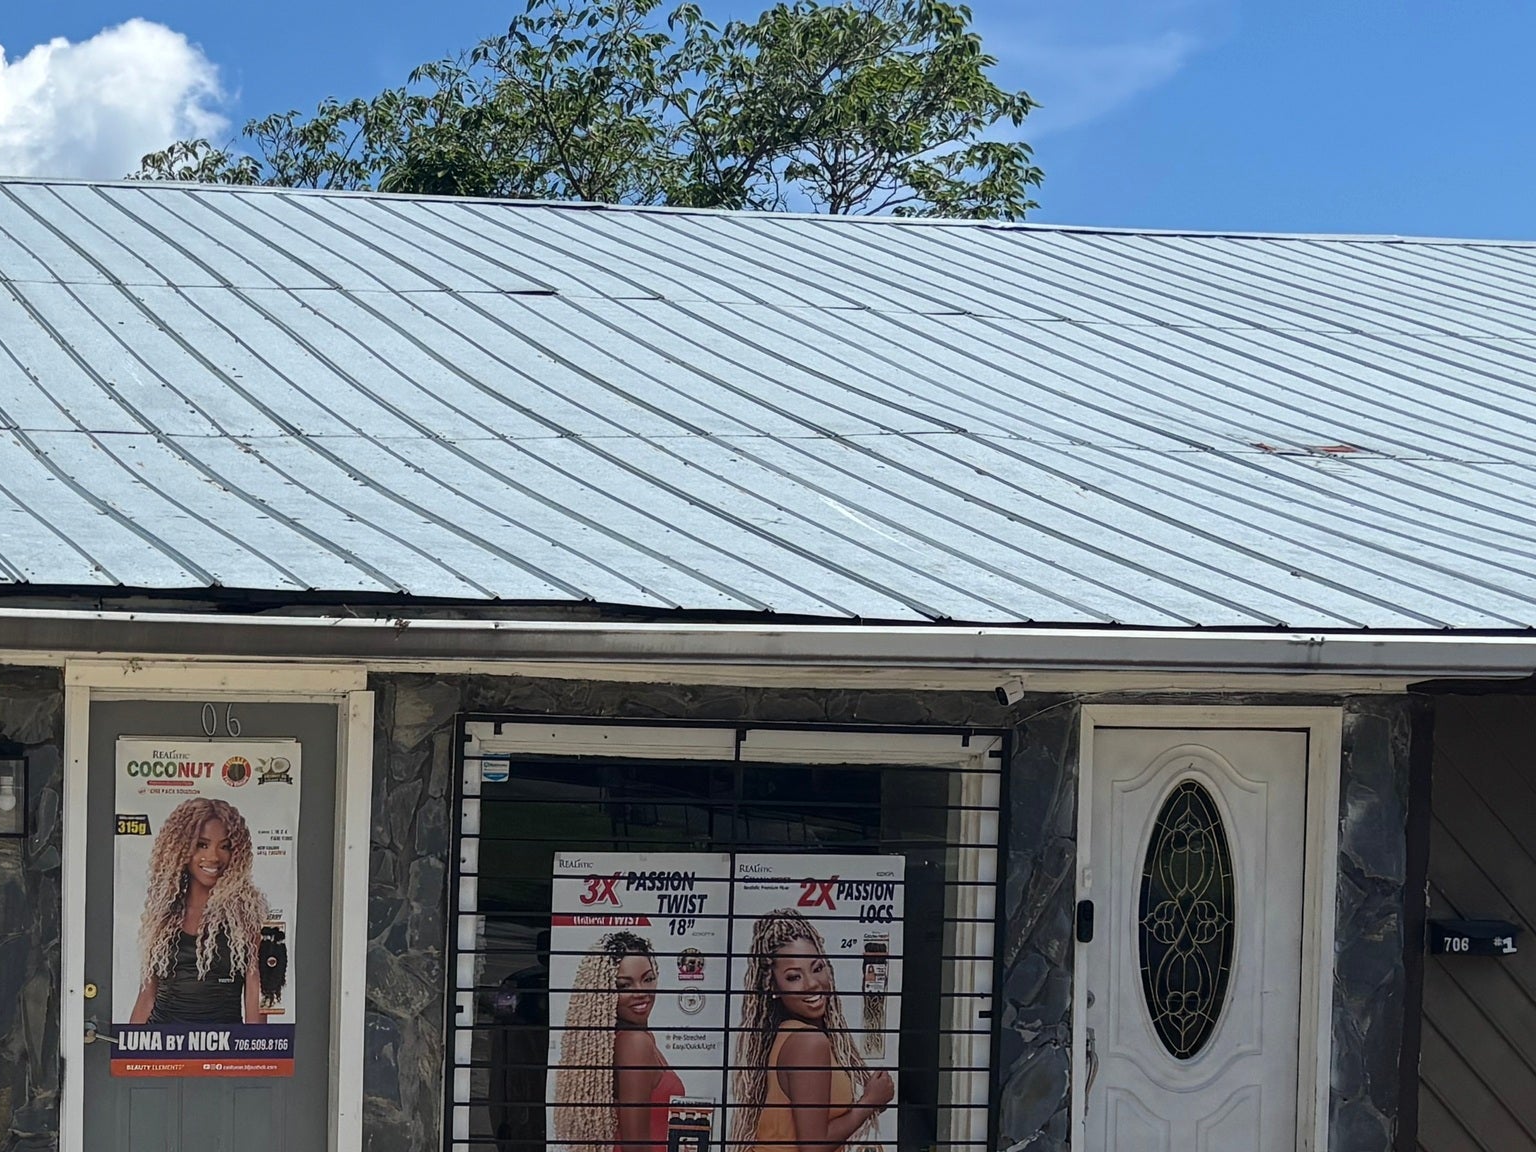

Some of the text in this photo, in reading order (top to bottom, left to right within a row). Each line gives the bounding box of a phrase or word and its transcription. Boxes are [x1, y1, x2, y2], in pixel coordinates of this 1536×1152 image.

[127, 761, 215, 778] COCONUT
[118, 820, 147, 834] 315g
[579, 872, 622, 906] 3X
[625, 871, 696, 891] PASSION
[797, 875, 840, 910] 2X
[836, 882, 895, 901] PASSION
[657, 894, 708, 914] TWIST
[859, 904, 894, 924] LOCS
[1443, 937, 1470, 952] 706
[118, 1031, 163, 1050] LUNA
[166, 1035, 185, 1051] BY
[188, 1031, 231, 1051] NICK
